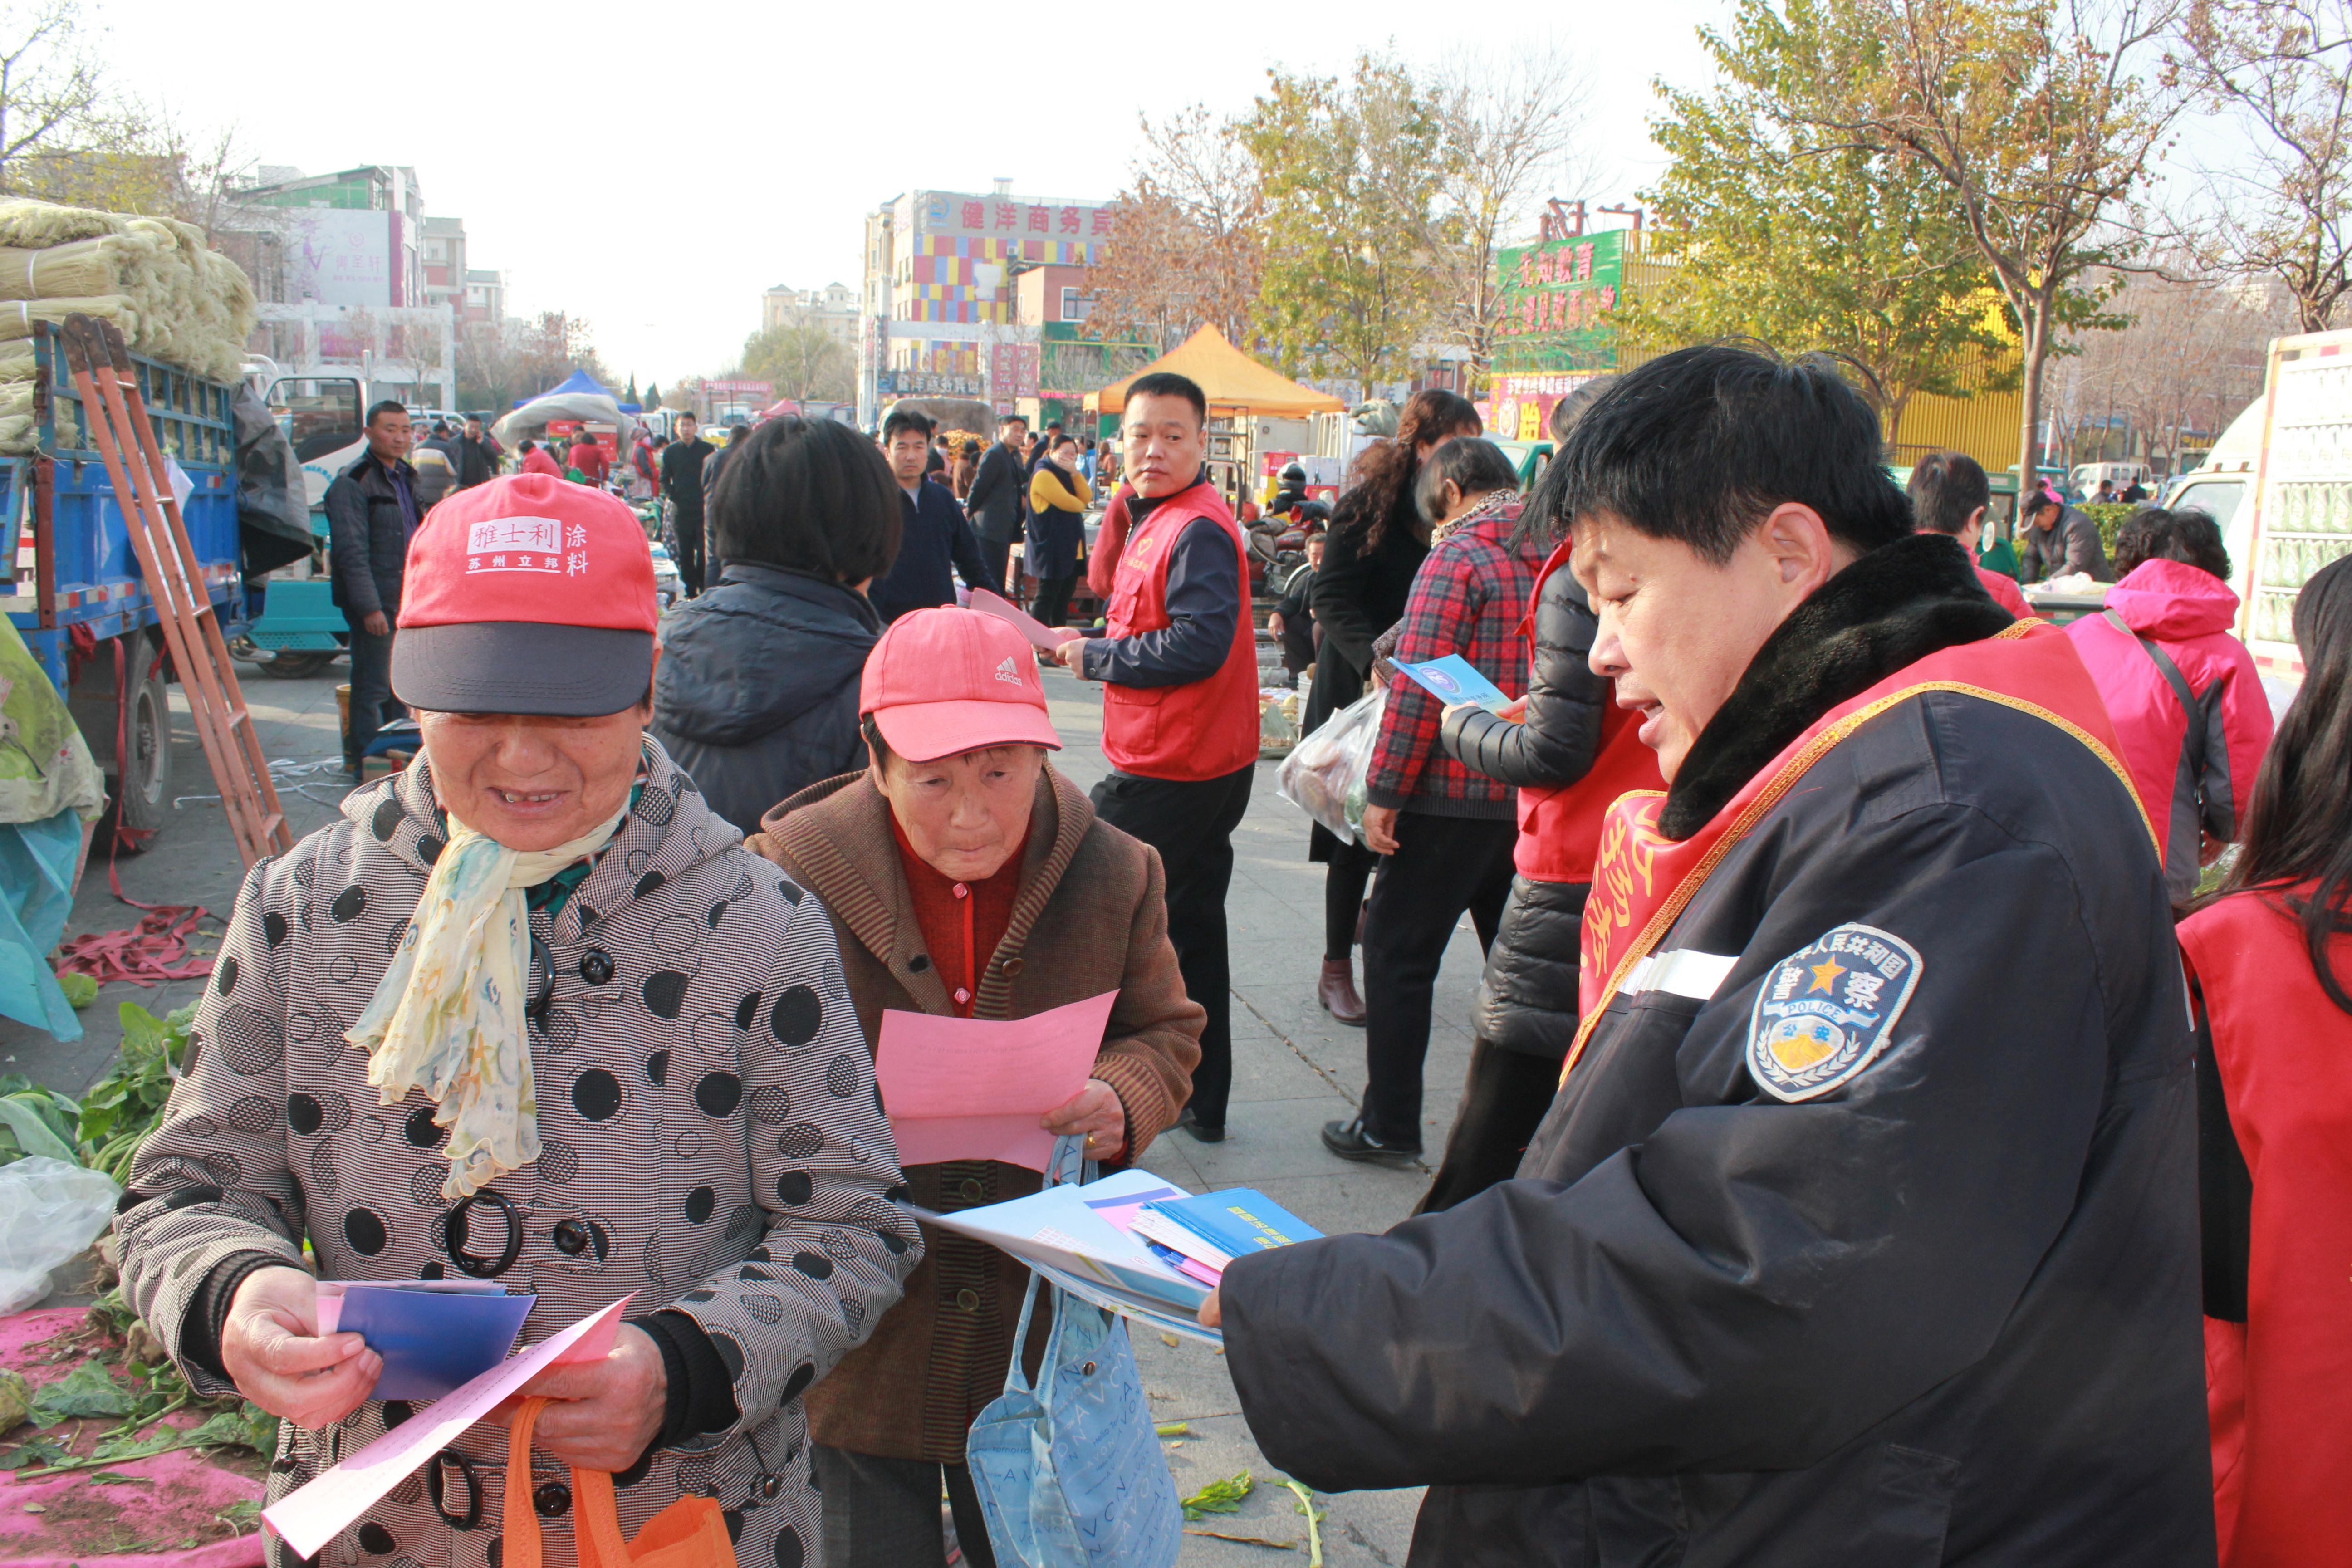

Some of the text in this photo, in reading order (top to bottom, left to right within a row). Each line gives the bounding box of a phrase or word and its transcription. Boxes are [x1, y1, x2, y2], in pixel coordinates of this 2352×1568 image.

[473, 524, 554, 549] 雅士利
[565, 523, 588, 577] 涂料
[468, 554, 558, 570] 苏州立邦
[1779, 933, 1907, 980] 人民共和国
[1787, 1001, 1842, 1020] POLICE
[1783, 1023, 1831, 1042] 公安
